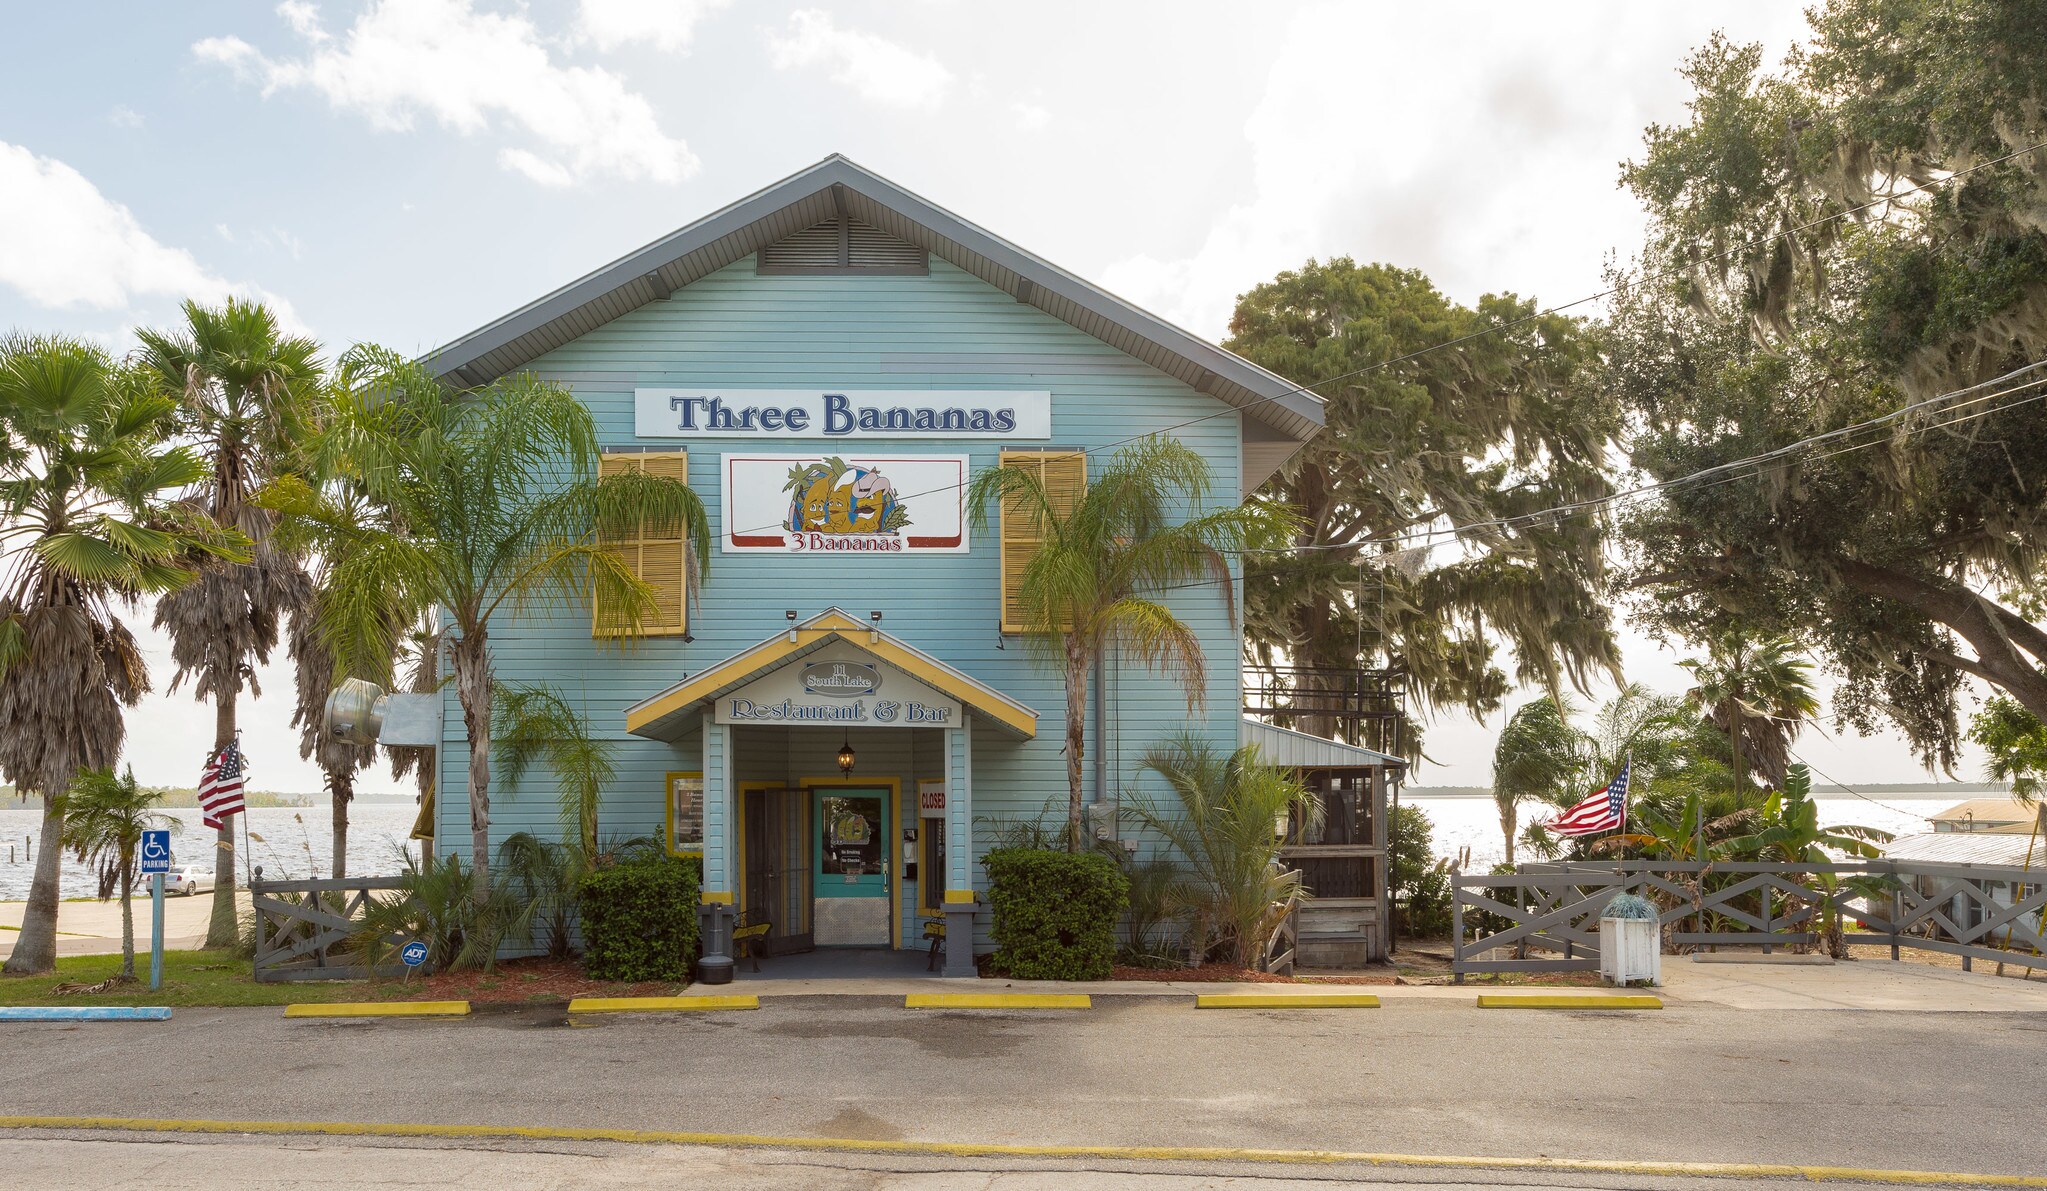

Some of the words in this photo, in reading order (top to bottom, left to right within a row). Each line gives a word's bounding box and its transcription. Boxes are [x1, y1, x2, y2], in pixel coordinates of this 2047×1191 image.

[670, 396, 809, 432] Three
[822, 394, 1016, 434] Bananas
[791, 533, 806, 551] 3
[810, 533, 902, 552] Bananas
[833, 664, 846, 676] 11
[806, 674, 841, 687] South
[844, 675, 872, 688] Lake
[729, 698, 865, 721] Restaurant
[873, 700, 899, 722] &
[905, 701, 949, 722] Bar
[921, 792, 945, 809] CLOSED
[143, 860, 168, 868] PARKING
[404, 949, 426, 959] ADT
